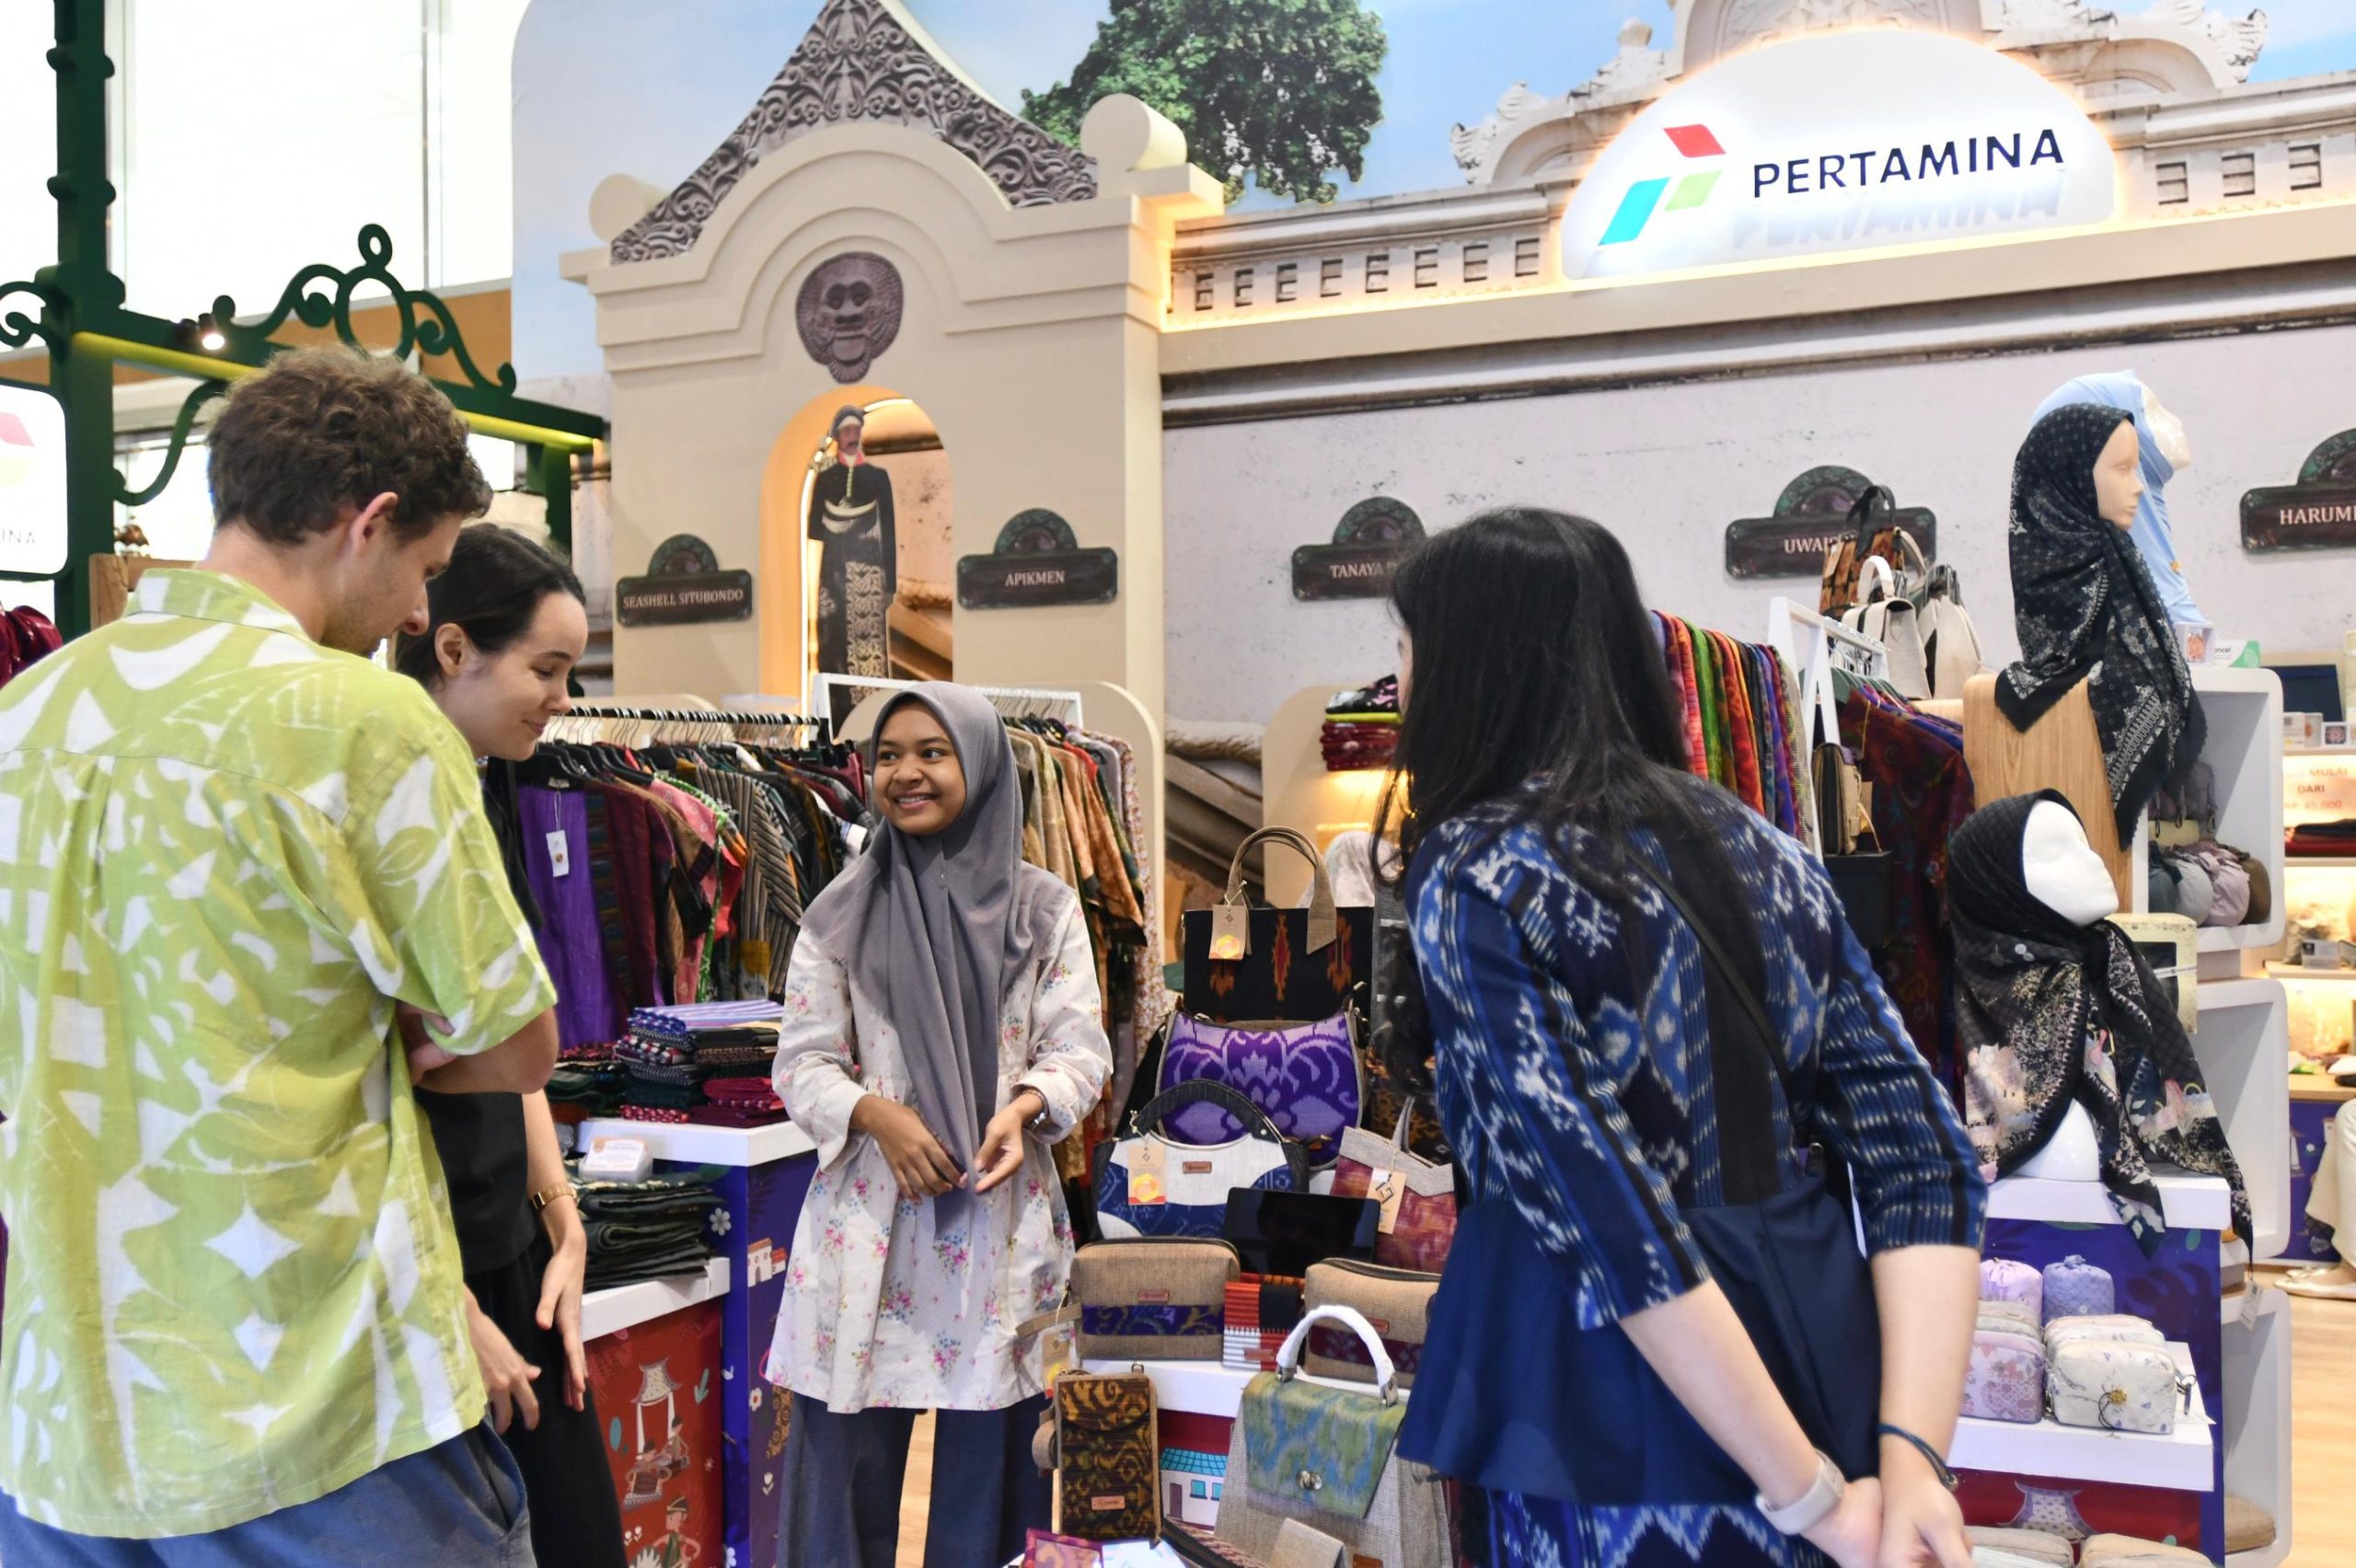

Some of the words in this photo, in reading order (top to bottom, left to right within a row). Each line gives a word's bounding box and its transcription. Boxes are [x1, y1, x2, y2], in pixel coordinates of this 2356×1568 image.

[1753, 129, 2064, 199] PERTAMINA
[1329, 562, 1384, 579] TANAYA
[1004, 571, 1066, 587] APIKMEN
[623, 593, 676, 609] SEASHELL
[678, 588, 745, 605] SITUBONDO
[2309, 767, 2348, 777] MULAI
[2297, 784, 2326, 794] DARI
